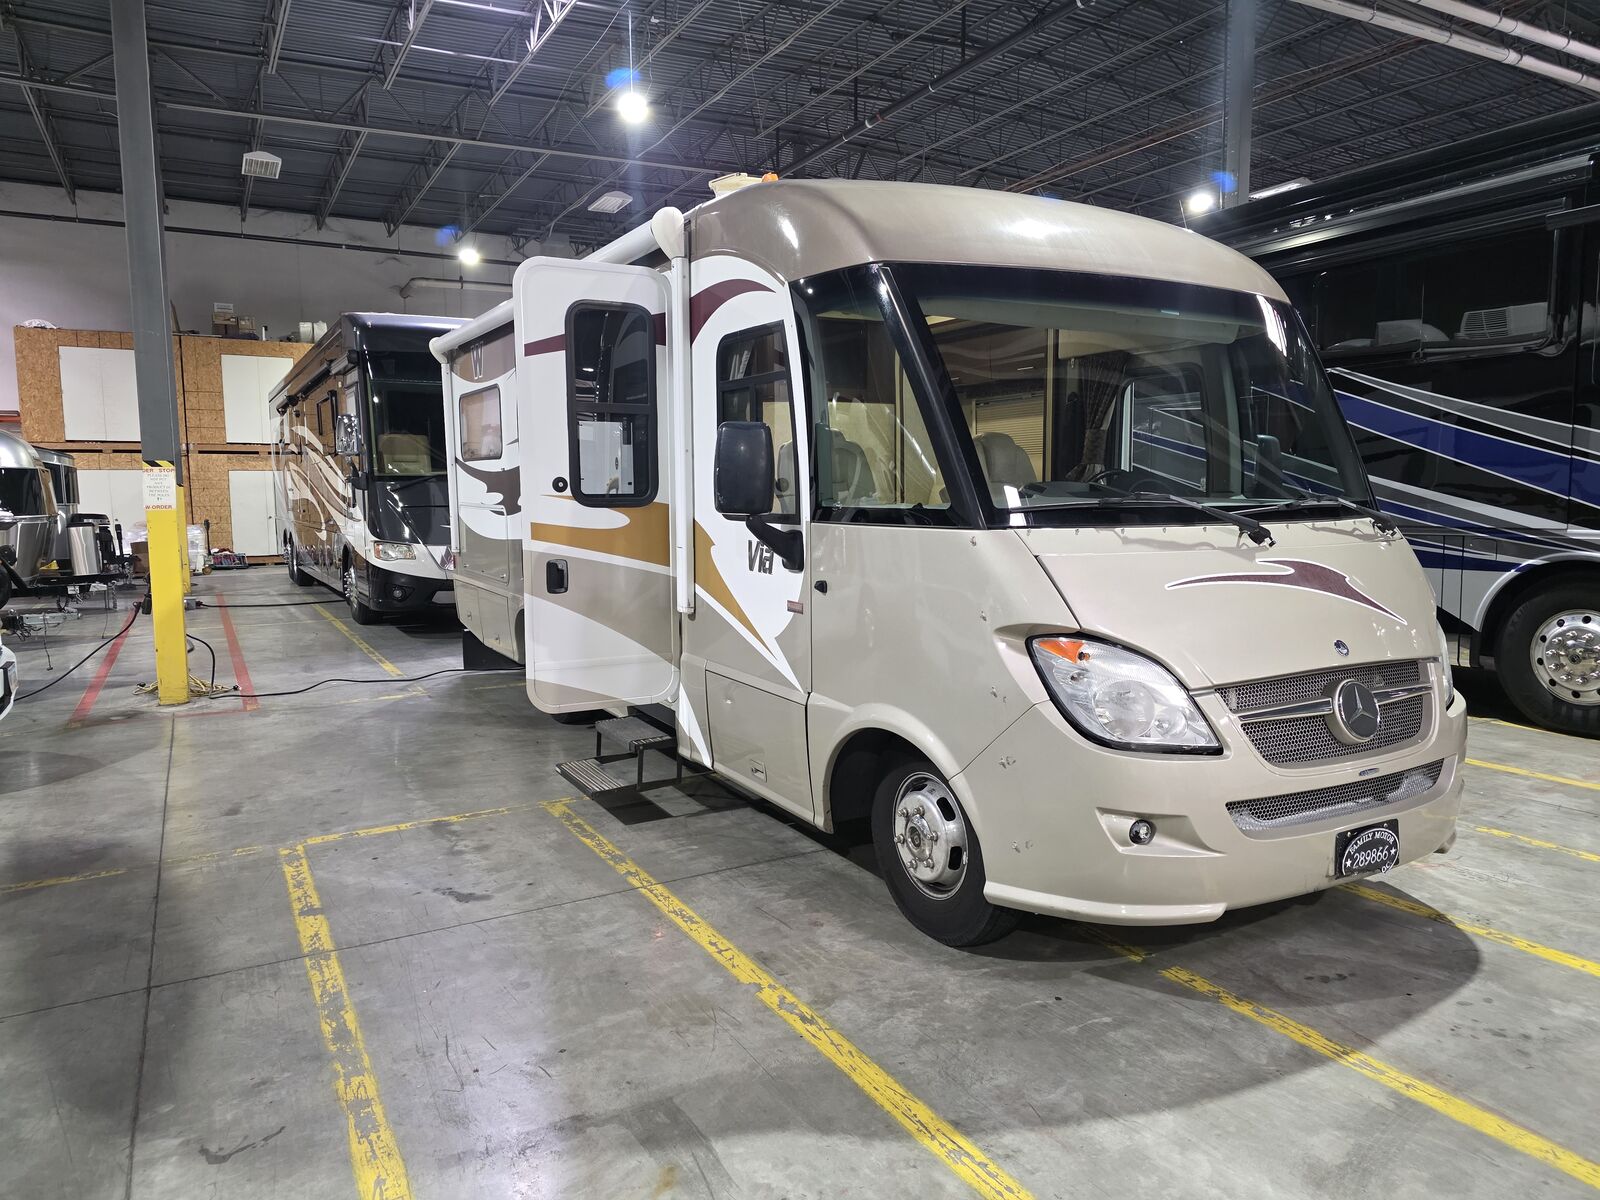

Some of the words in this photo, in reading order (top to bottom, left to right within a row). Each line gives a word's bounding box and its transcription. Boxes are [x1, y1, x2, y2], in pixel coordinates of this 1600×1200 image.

[1350, 832, 1373, 855] FAMILY
[1374, 831, 1395, 845] MOTOR
[1353, 846, 1389, 869] 289866
